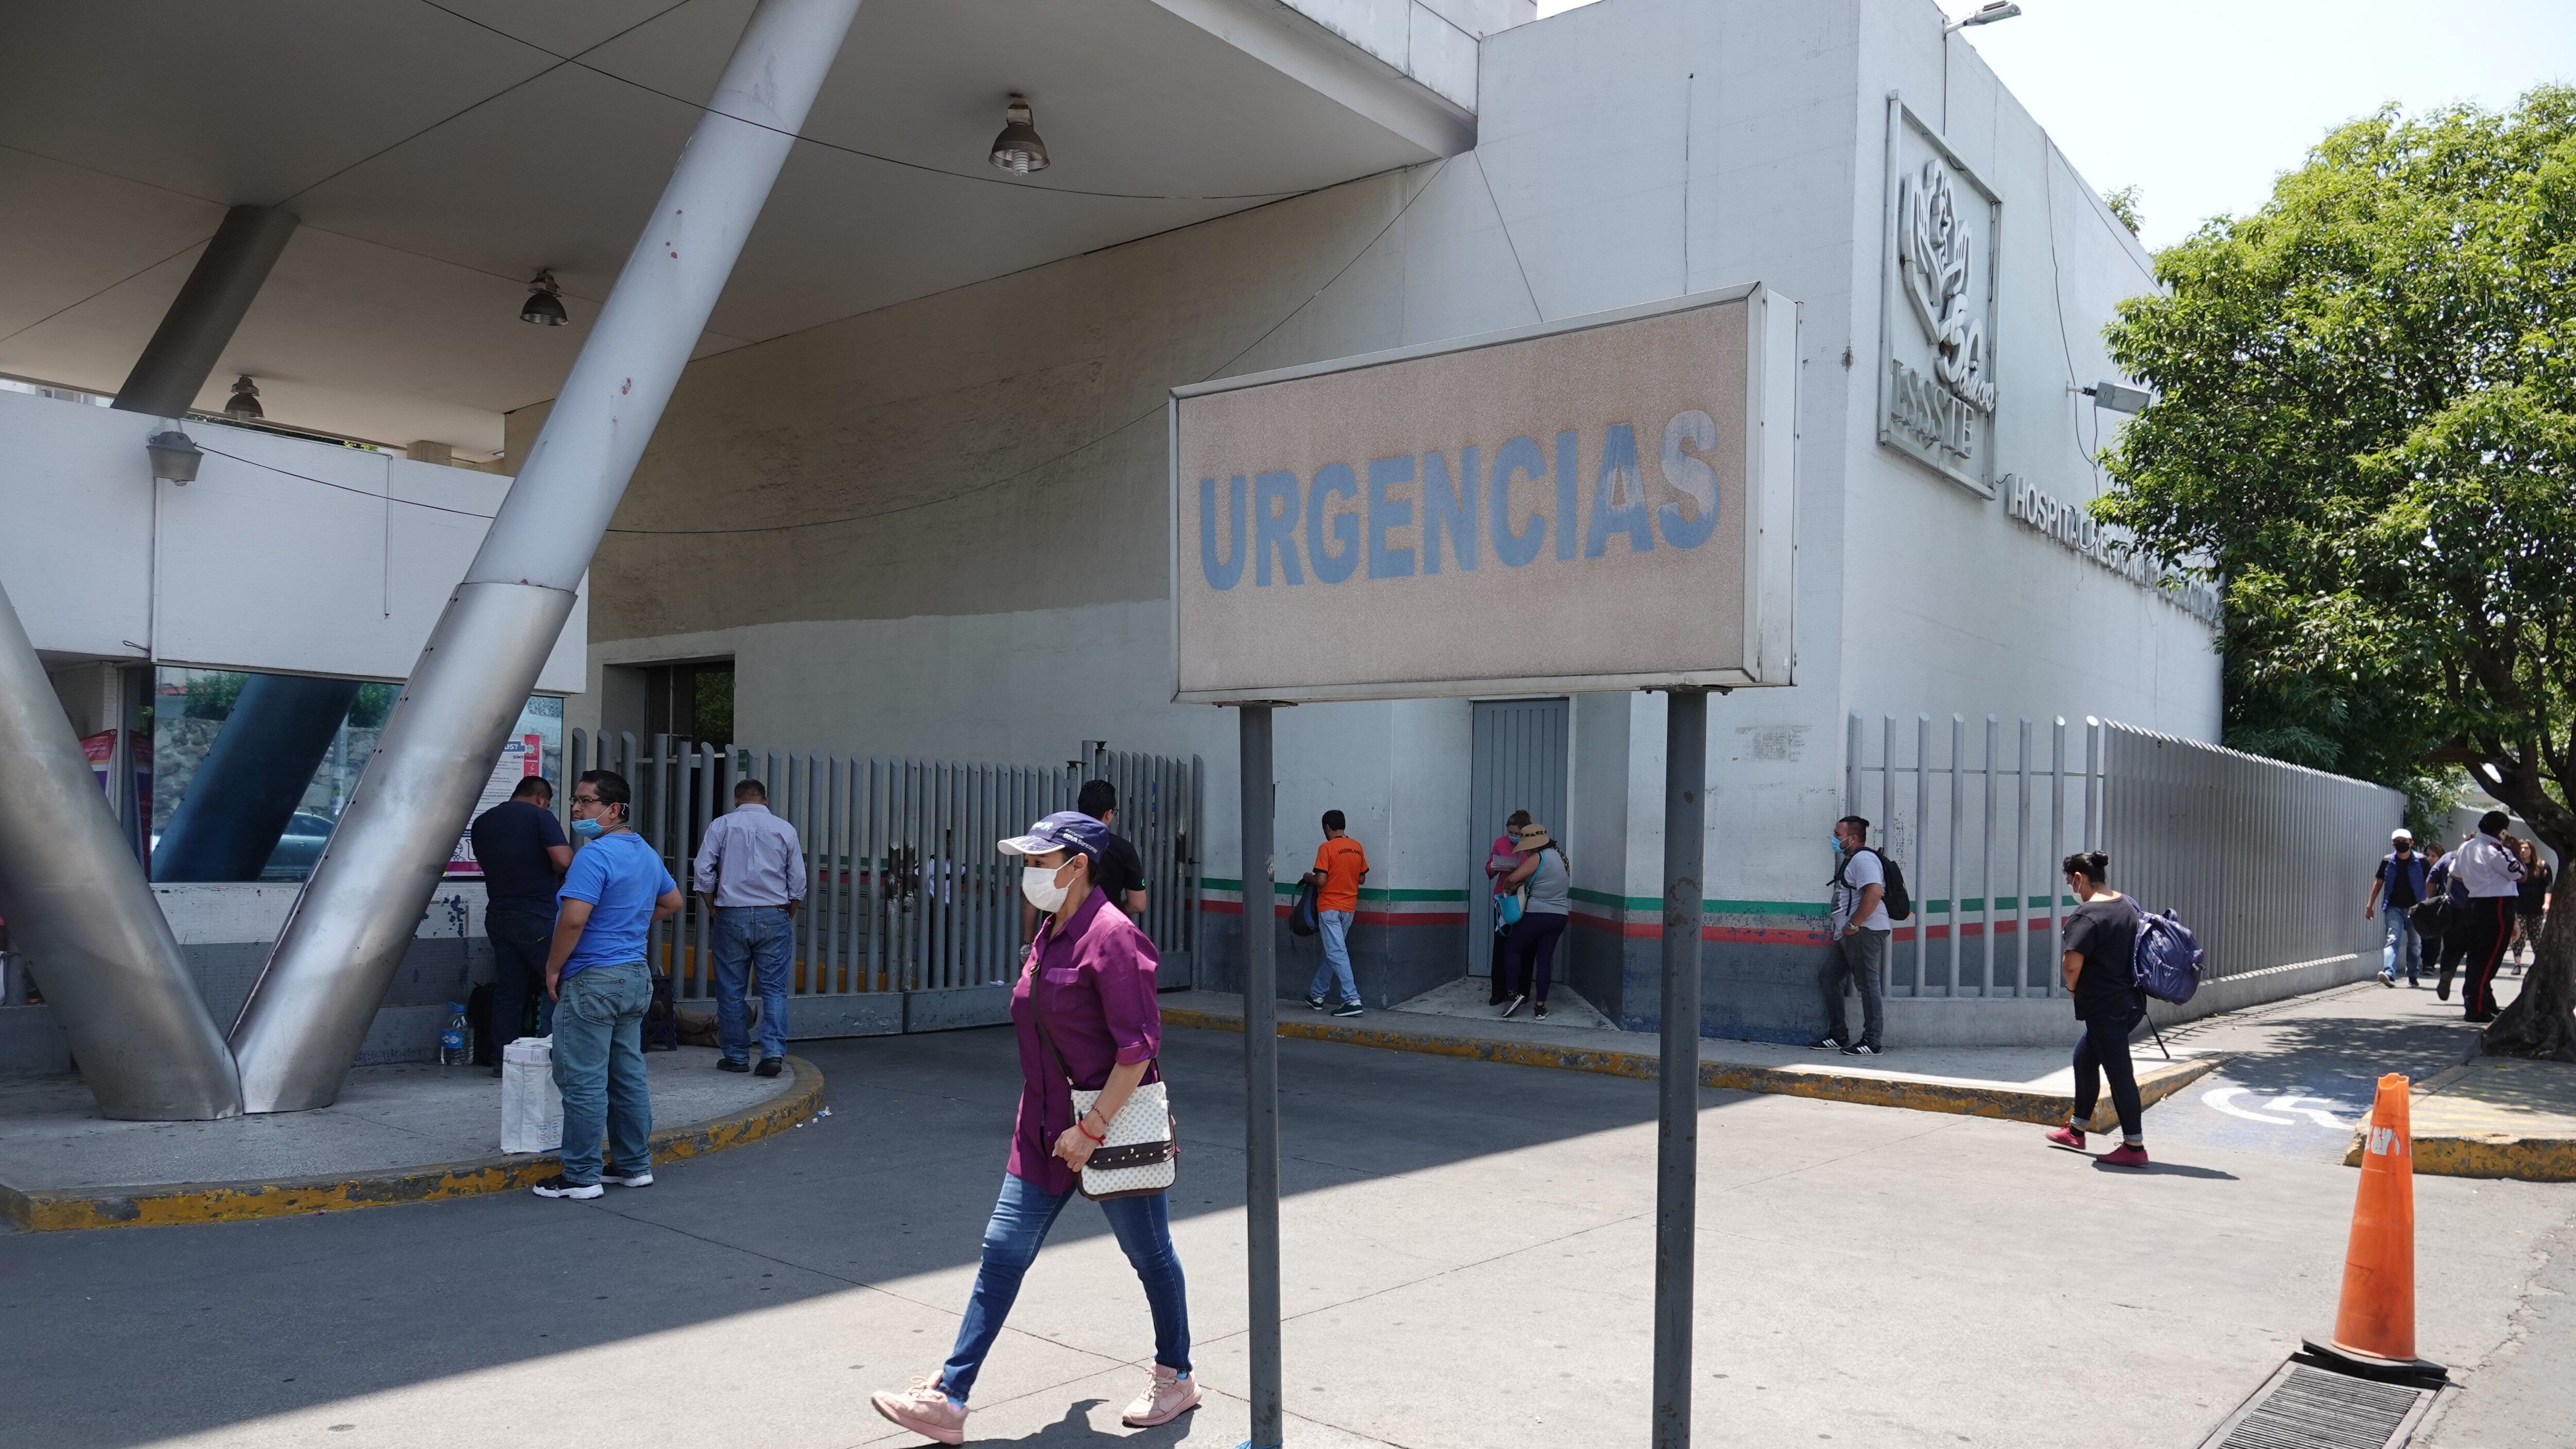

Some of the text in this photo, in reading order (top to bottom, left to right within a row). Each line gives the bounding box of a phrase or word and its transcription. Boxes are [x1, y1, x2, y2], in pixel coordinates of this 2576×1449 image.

[1892, 359, 1974, 456] ISSSTE
[1199, 410, 1721, 591] URGENCIAS
[2012, 473, 2088, 554] HOSPITAL
[1063, 833, 1078, 843] BBVA
